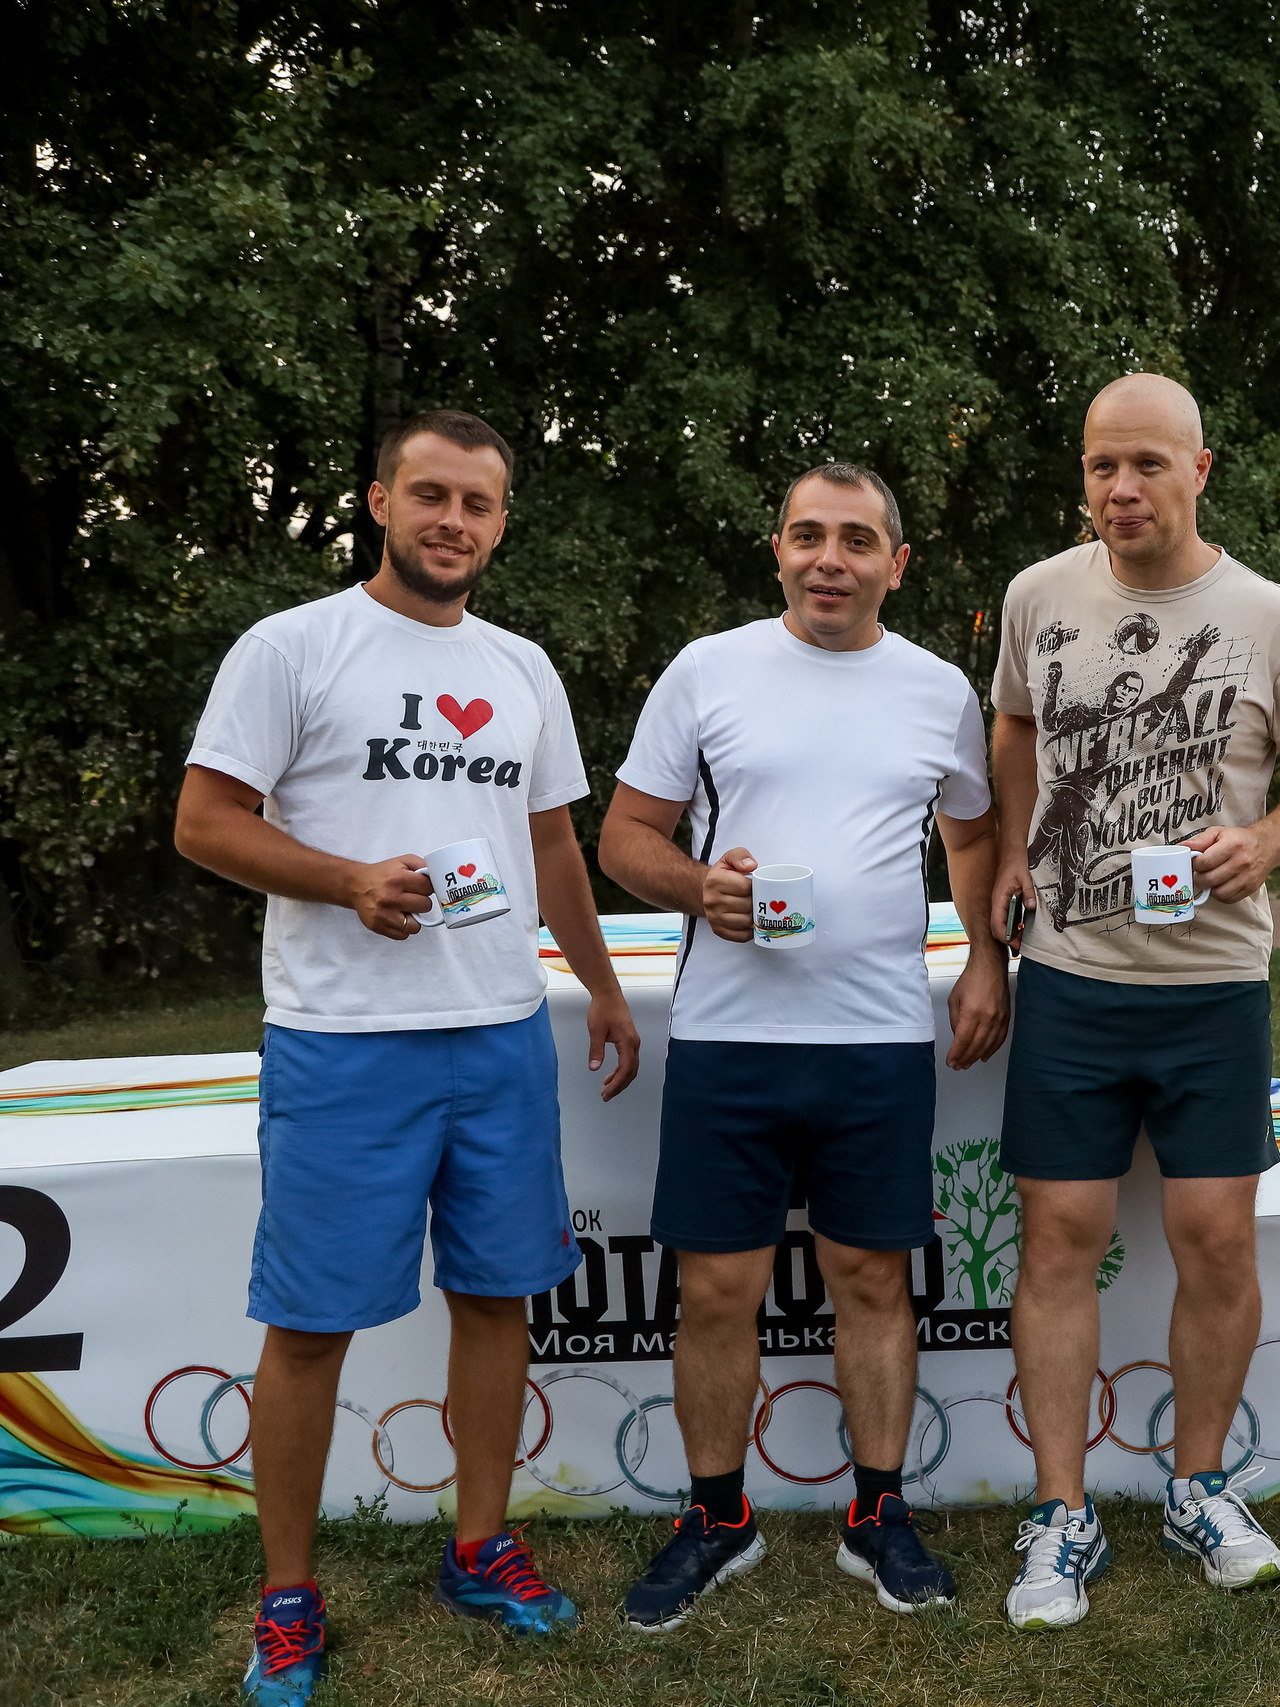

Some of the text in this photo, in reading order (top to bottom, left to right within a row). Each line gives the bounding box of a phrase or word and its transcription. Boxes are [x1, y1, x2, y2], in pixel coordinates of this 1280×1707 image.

[400, 693, 423, 731] I
[1155, 685, 1237, 750] ALL
[362, 737, 523, 789] Korea
[417, 739, 463, 753] 대한민국
[1104, 735, 1232, 796] DIFFERENT
[1086, 768, 1226, 851] Volleyball
[1137, 779, 1175, 810] BUT
[444, 871, 457, 888] Я
[1079, 875, 1133, 917] UNIT
[1147, 878, 1159, 891] Я
[758, 901, 767, 915] Я
[528, 1329, 615, 1356] Моя
